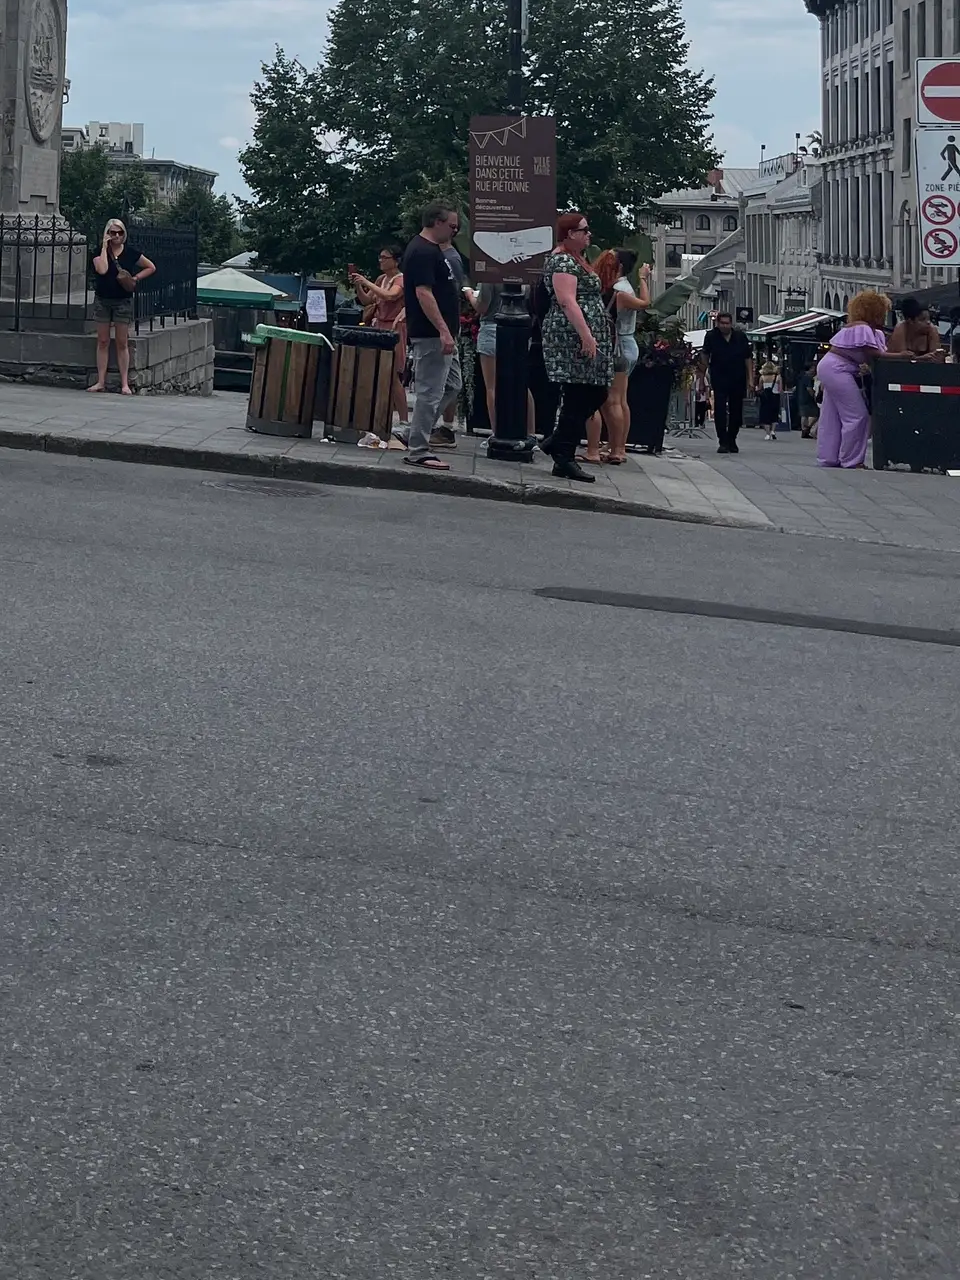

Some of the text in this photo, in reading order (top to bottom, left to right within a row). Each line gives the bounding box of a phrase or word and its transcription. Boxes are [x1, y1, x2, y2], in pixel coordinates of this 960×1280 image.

[475, 154, 521, 167] BIENVENUE
[533, 156, 551, 167] VILLE
[475, 167, 524, 180] DANS CETTE
[475, 180, 530, 193] RUE PIÉTONNE
[925, 183, 945, 192] ZONE
